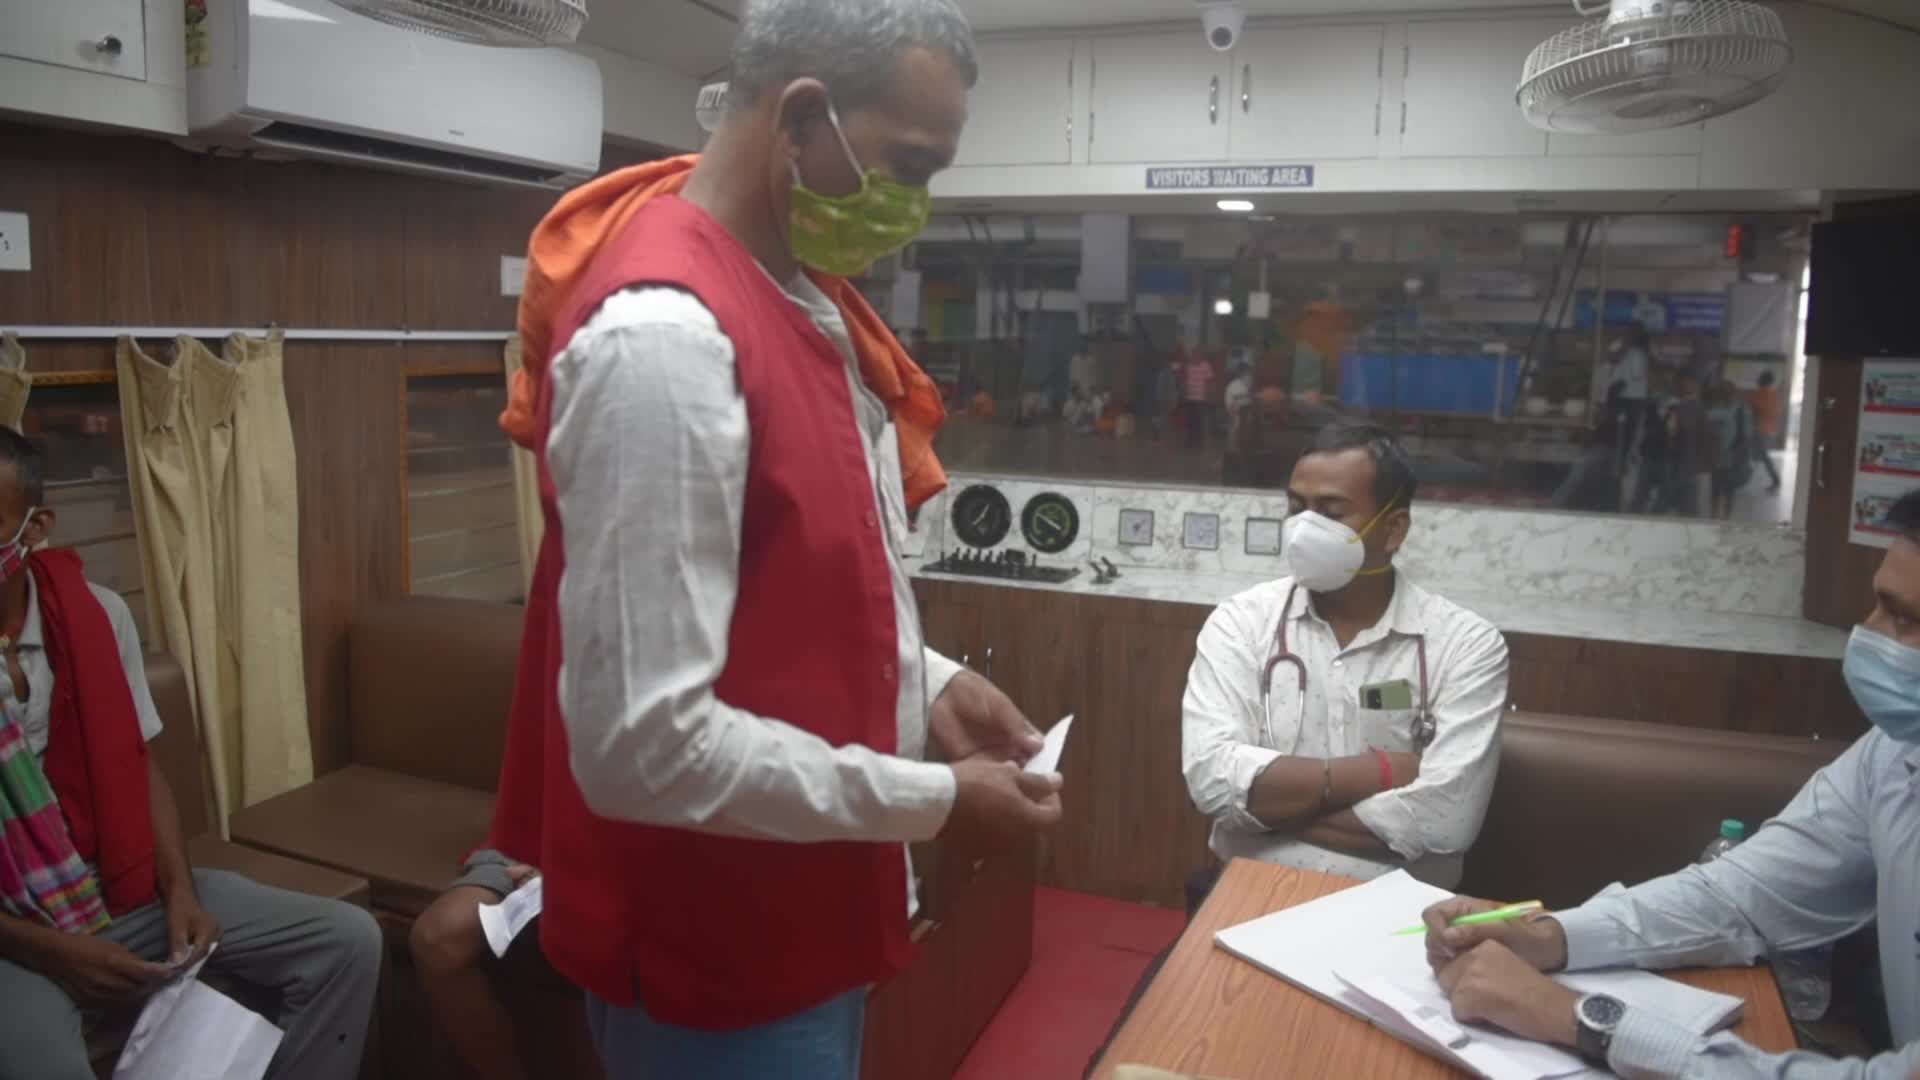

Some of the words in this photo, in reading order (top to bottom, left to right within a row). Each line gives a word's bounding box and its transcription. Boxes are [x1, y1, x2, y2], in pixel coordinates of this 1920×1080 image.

[1151, 169, 1209, 187] VISITORS
[1213, 168, 1269, 186] WAITING
[1271, 167, 1308, 185] AREA
